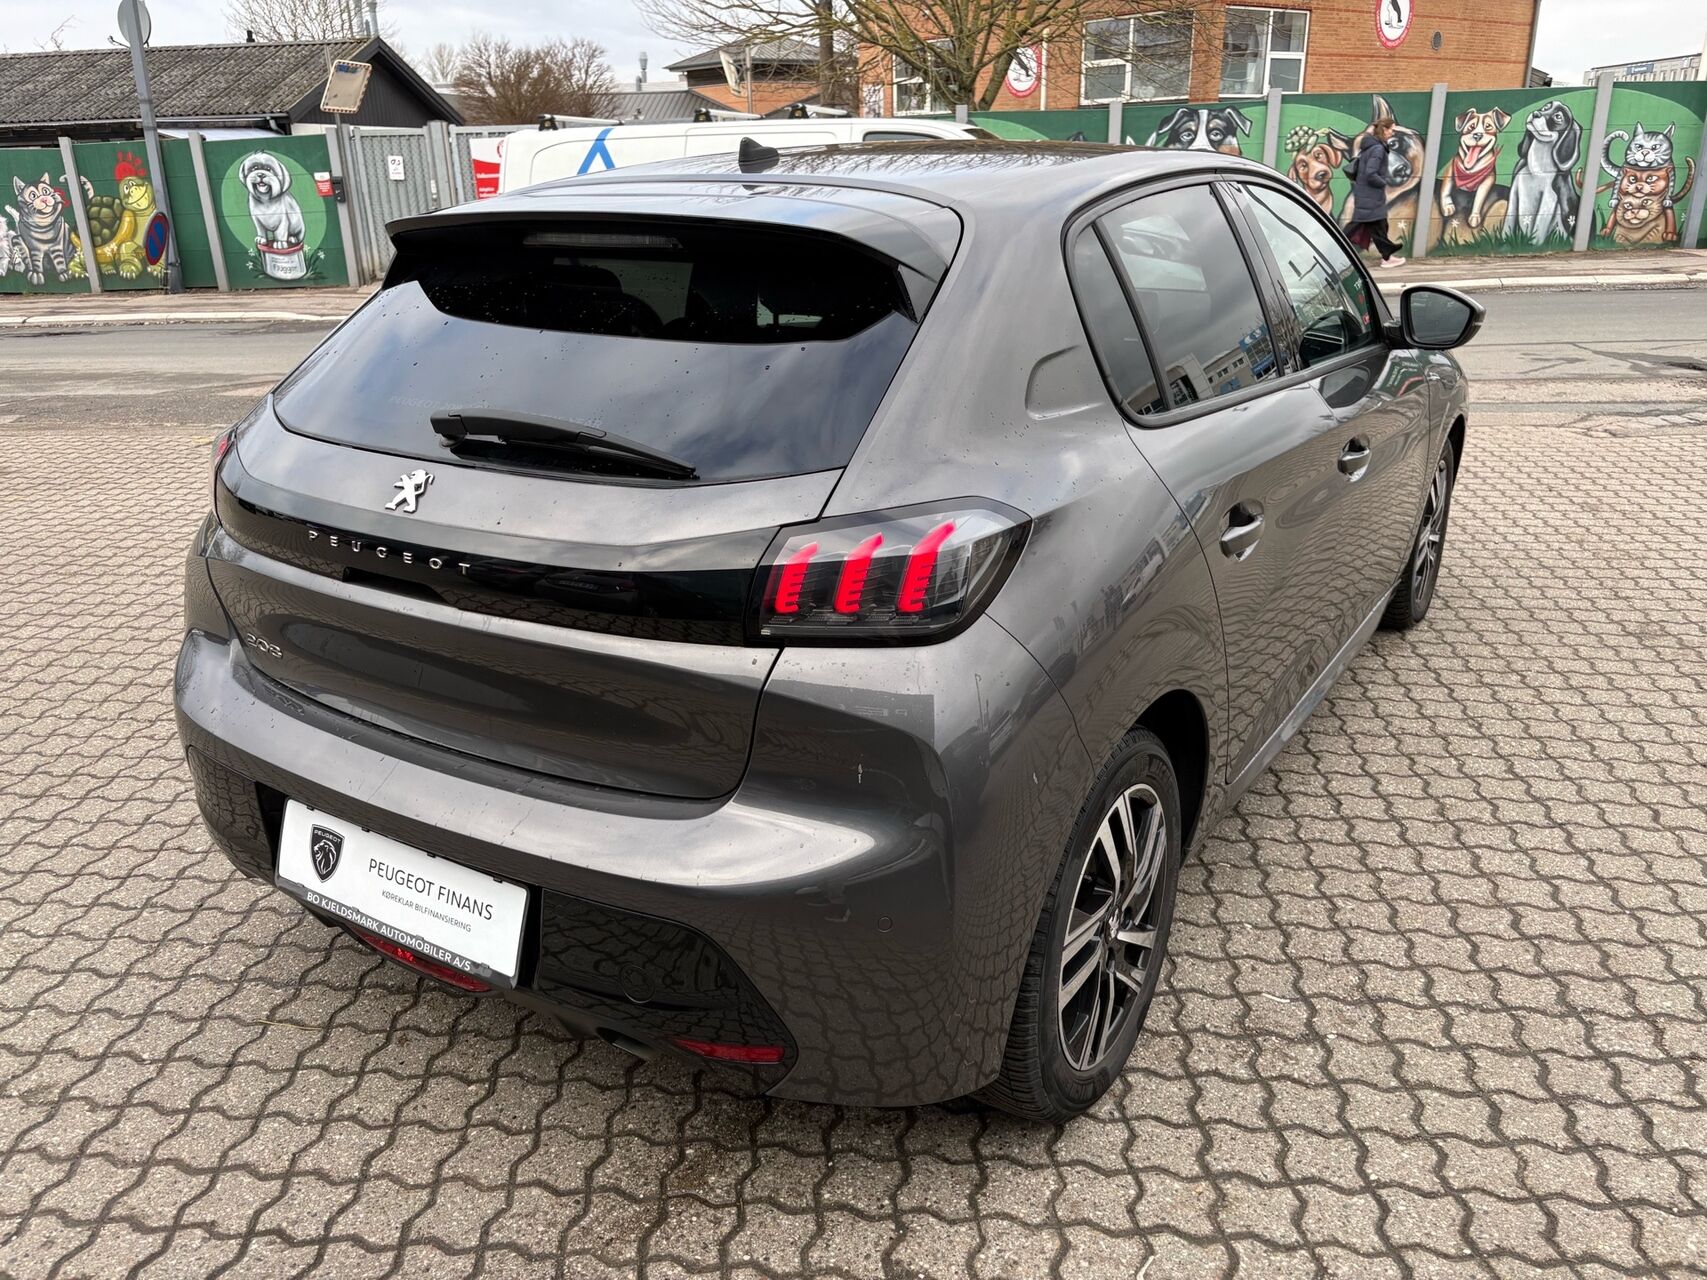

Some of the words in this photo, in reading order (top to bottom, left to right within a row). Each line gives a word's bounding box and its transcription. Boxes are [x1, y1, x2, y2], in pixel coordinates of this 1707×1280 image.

[308, 530, 472, 575] PEUGEOT
[247, 633, 283, 659] 208
[313, 828, 342, 844] PEUGEOT
[368, 858, 435, 897] PEUGEOT
[438, 885, 493, 921] FINANS
[381, 889, 414, 909] KØREKLAR
[414, 903, 472, 933] BILFINANSIERING
[307, 892, 320, 905] BO
[321, 897, 379, 931] KJELDSMARK
[380, 925, 452, 964] AUTOMOBILER
[453, 953, 472, 971] A/S
